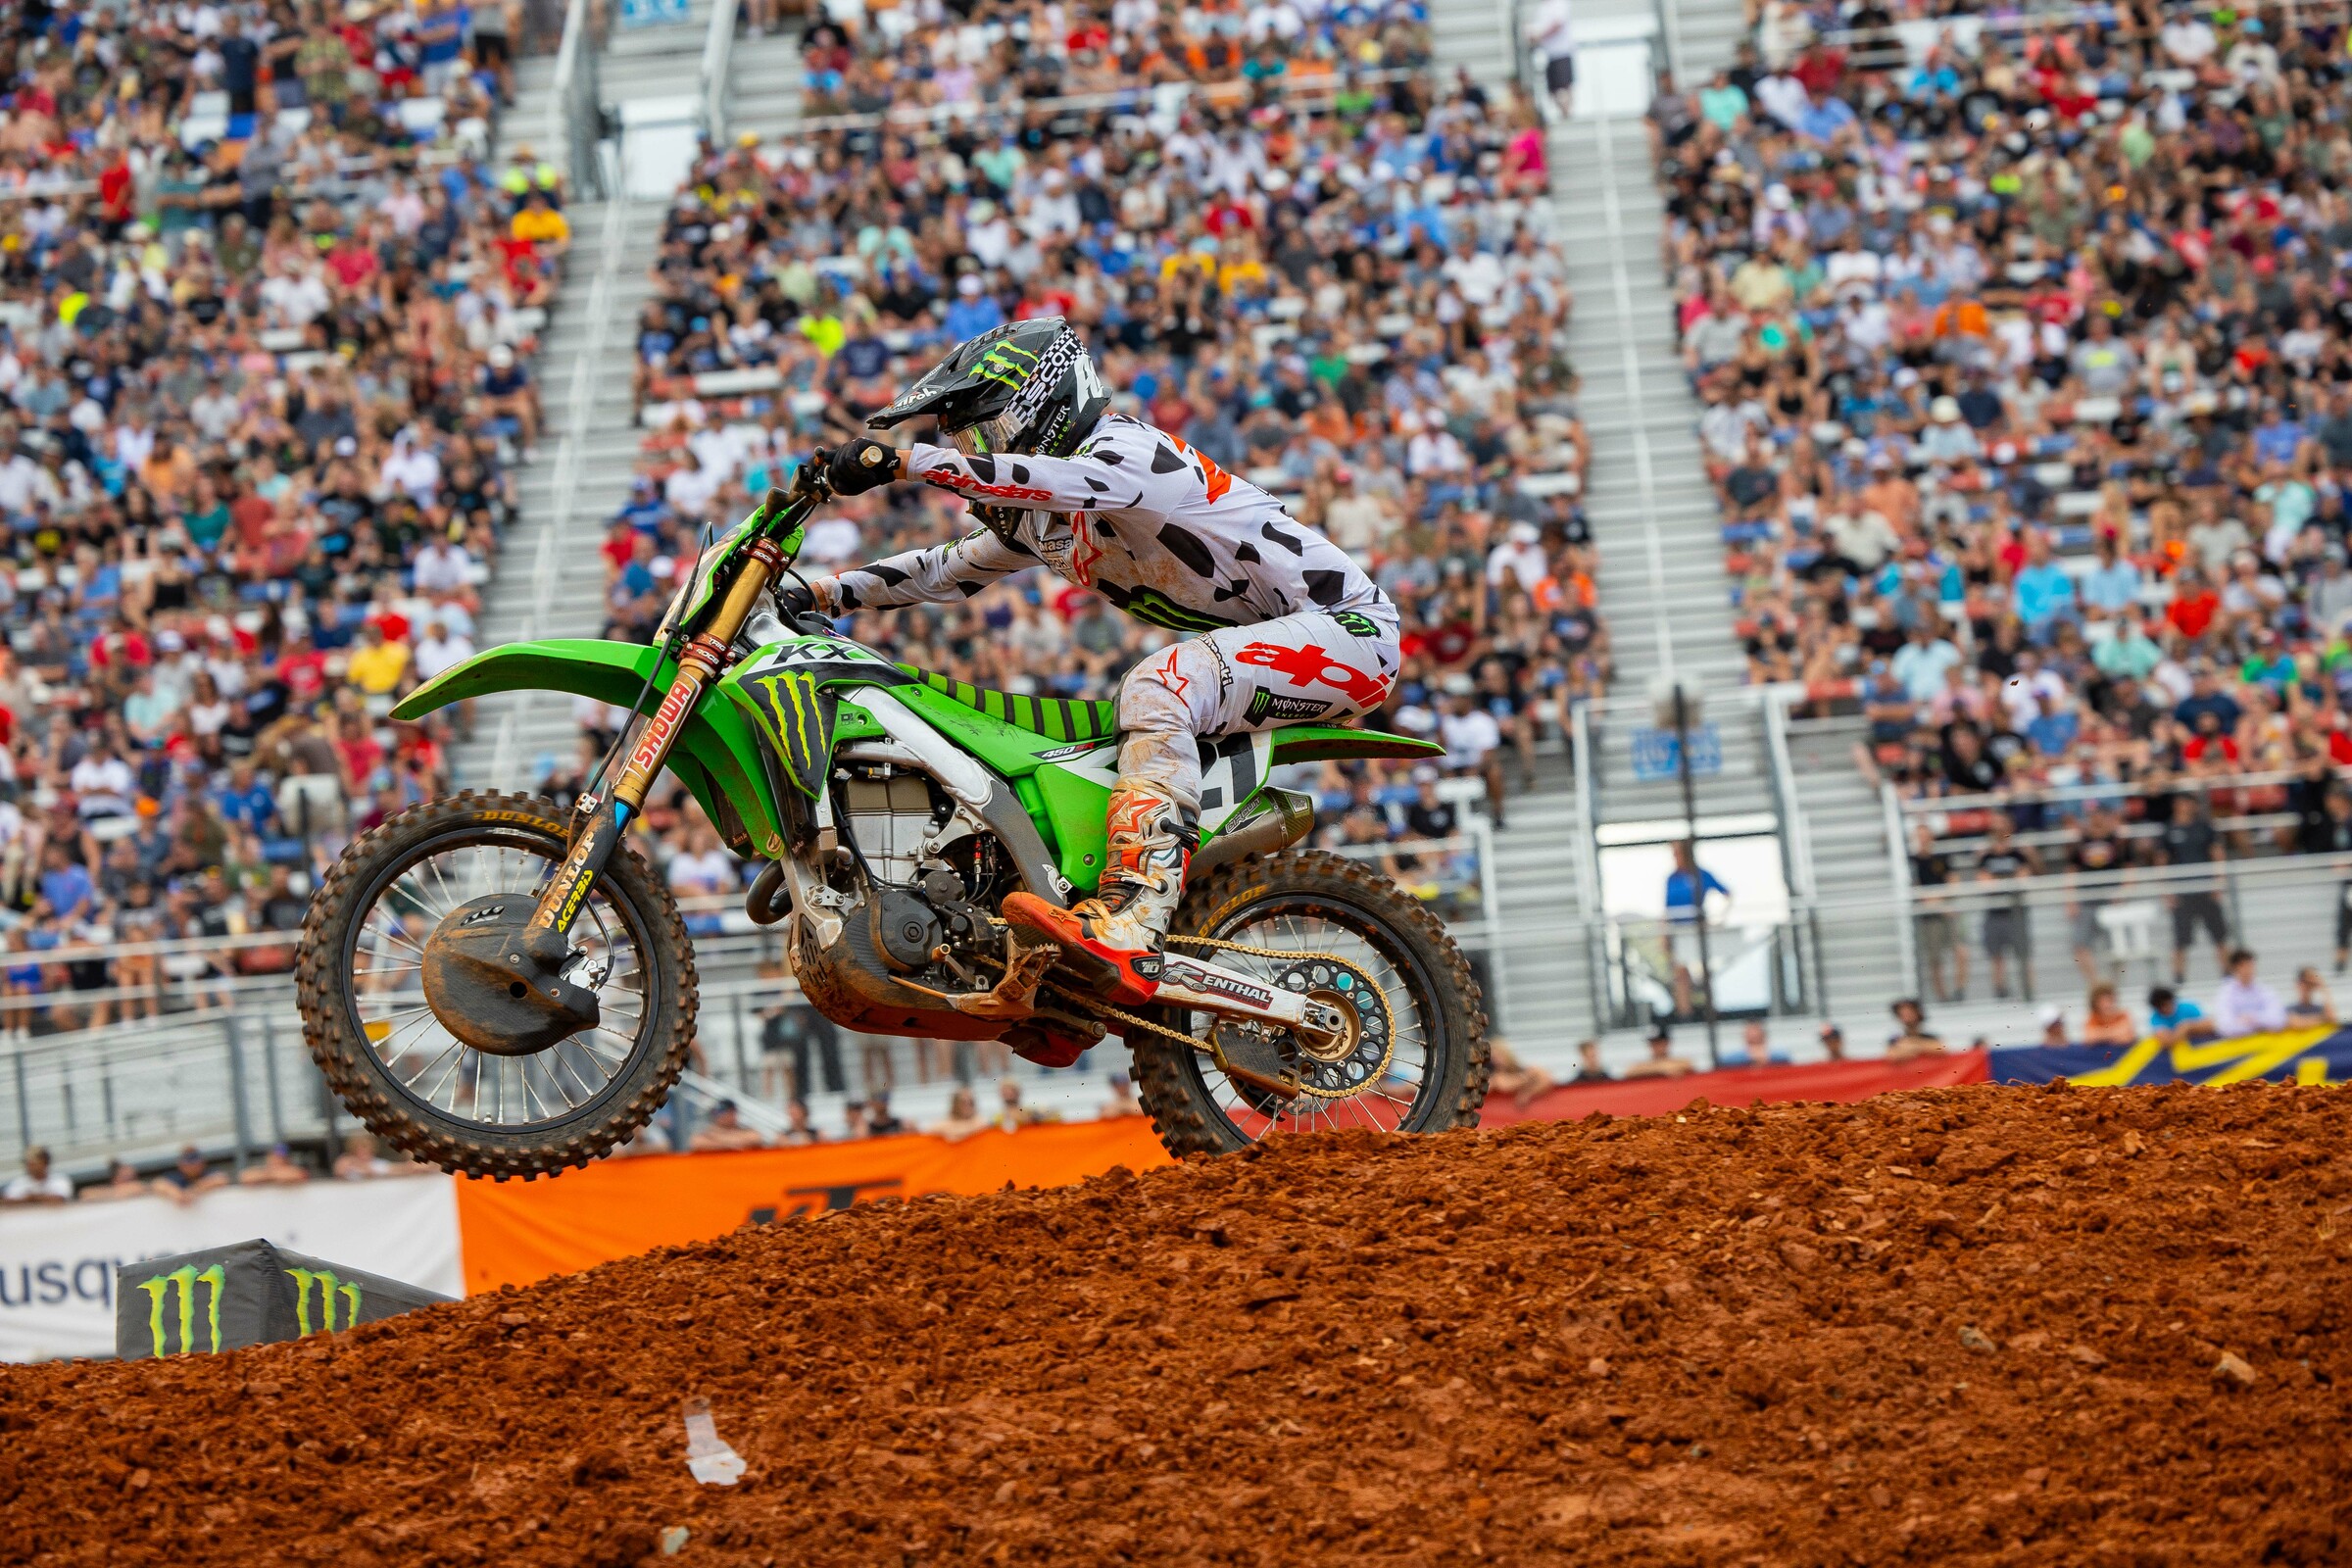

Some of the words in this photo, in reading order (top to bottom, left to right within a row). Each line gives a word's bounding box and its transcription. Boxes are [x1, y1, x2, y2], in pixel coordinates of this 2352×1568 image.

[1025, 338, 1078, 404] SCOTT
[1036, 405, 1071, 455] ONSTER
[1049, 419, 1071, 455] NERGY
[773, 643, 856, 664] KX
[633, 680, 692, 772] SHOWA
[1271, 698, 1327, 712] MONSTER
[1225, 797, 1261, 833] CIRCUIT
[539, 831, 595, 928] DUNLOP
